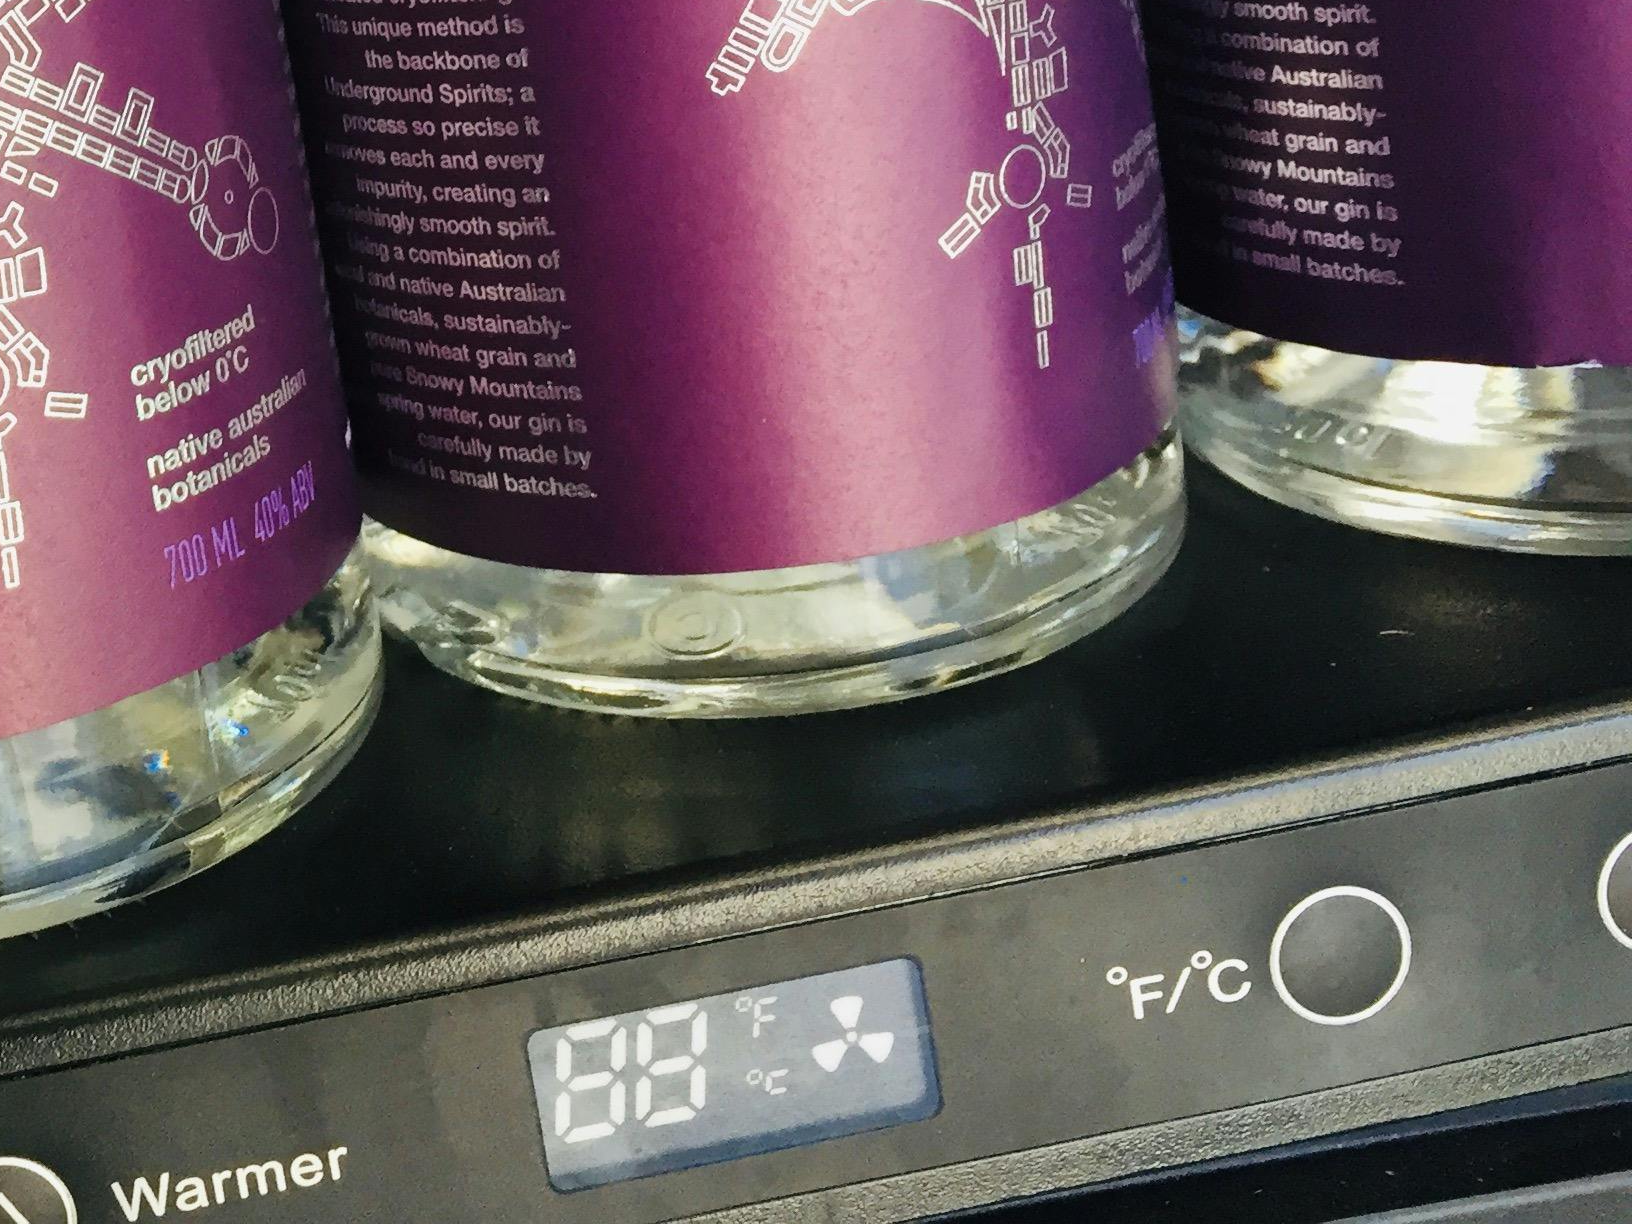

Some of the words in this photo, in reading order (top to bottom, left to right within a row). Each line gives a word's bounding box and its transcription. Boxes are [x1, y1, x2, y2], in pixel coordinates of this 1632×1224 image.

[352, 17, 412, 41] unique
[417, 15, 498, 37] method
[504, 14, 525, 34] is
[365, 50, 393, 69] the
[397, 50, 500, 70] backbone
[506, 47, 529, 68] of
[1271, 64, 1383, 89] Australian
[520, 86, 536, 102] a
[412, 120, 434, 135] so
[441, 117, 519, 141] precise
[525, 115, 542, 136] it
[1285, 131, 1338, 153] grain
[390, 149, 434, 168] each
[440, 150, 478, 170] and
[484, 153, 545, 174] every
[1277, 158, 1395, 189] Mountains
[432, 183, 516, 208] creating
[522, 187, 550, 203] an
[419, 217, 491, 236] smooth
[497, 216, 555, 240] spirit.
[409, 247, 531, 270] combination
[538, 248, 560, 270] of
[1306, 257, 1406, 286] batches.
[400, 276, 454, 297] native
[459, 281, 567, 303] Australian
[130, 304, 255, 387] cryofiltered
[476, 347, 528, 369] grain
[533, 348, 576, 368] and
[135, 371, 210, 421] below
[469, 376, 583, 402] Mountains
[146, 428, 222, 479] native
[228, 368, 307, 439] australian
[428, 404, 483, 429] water,
[488, 413, 522, 430] our
[566, 413, 587, 434] is
[499, 443, 558, 464] made
[563, 445, 591, 470] by
[152, 434, 271, 512] botanicals
[450, 467, 498, 490] small
[503, 473, 598, 499] batches.
[164, 533, 208, 590] 700
[211, 517, 245, 568] ML
[254, 487, 289, 542] 40%
[291, 461, 315, 519] ABV
[110, 1146, 347, 1222] Warmer
